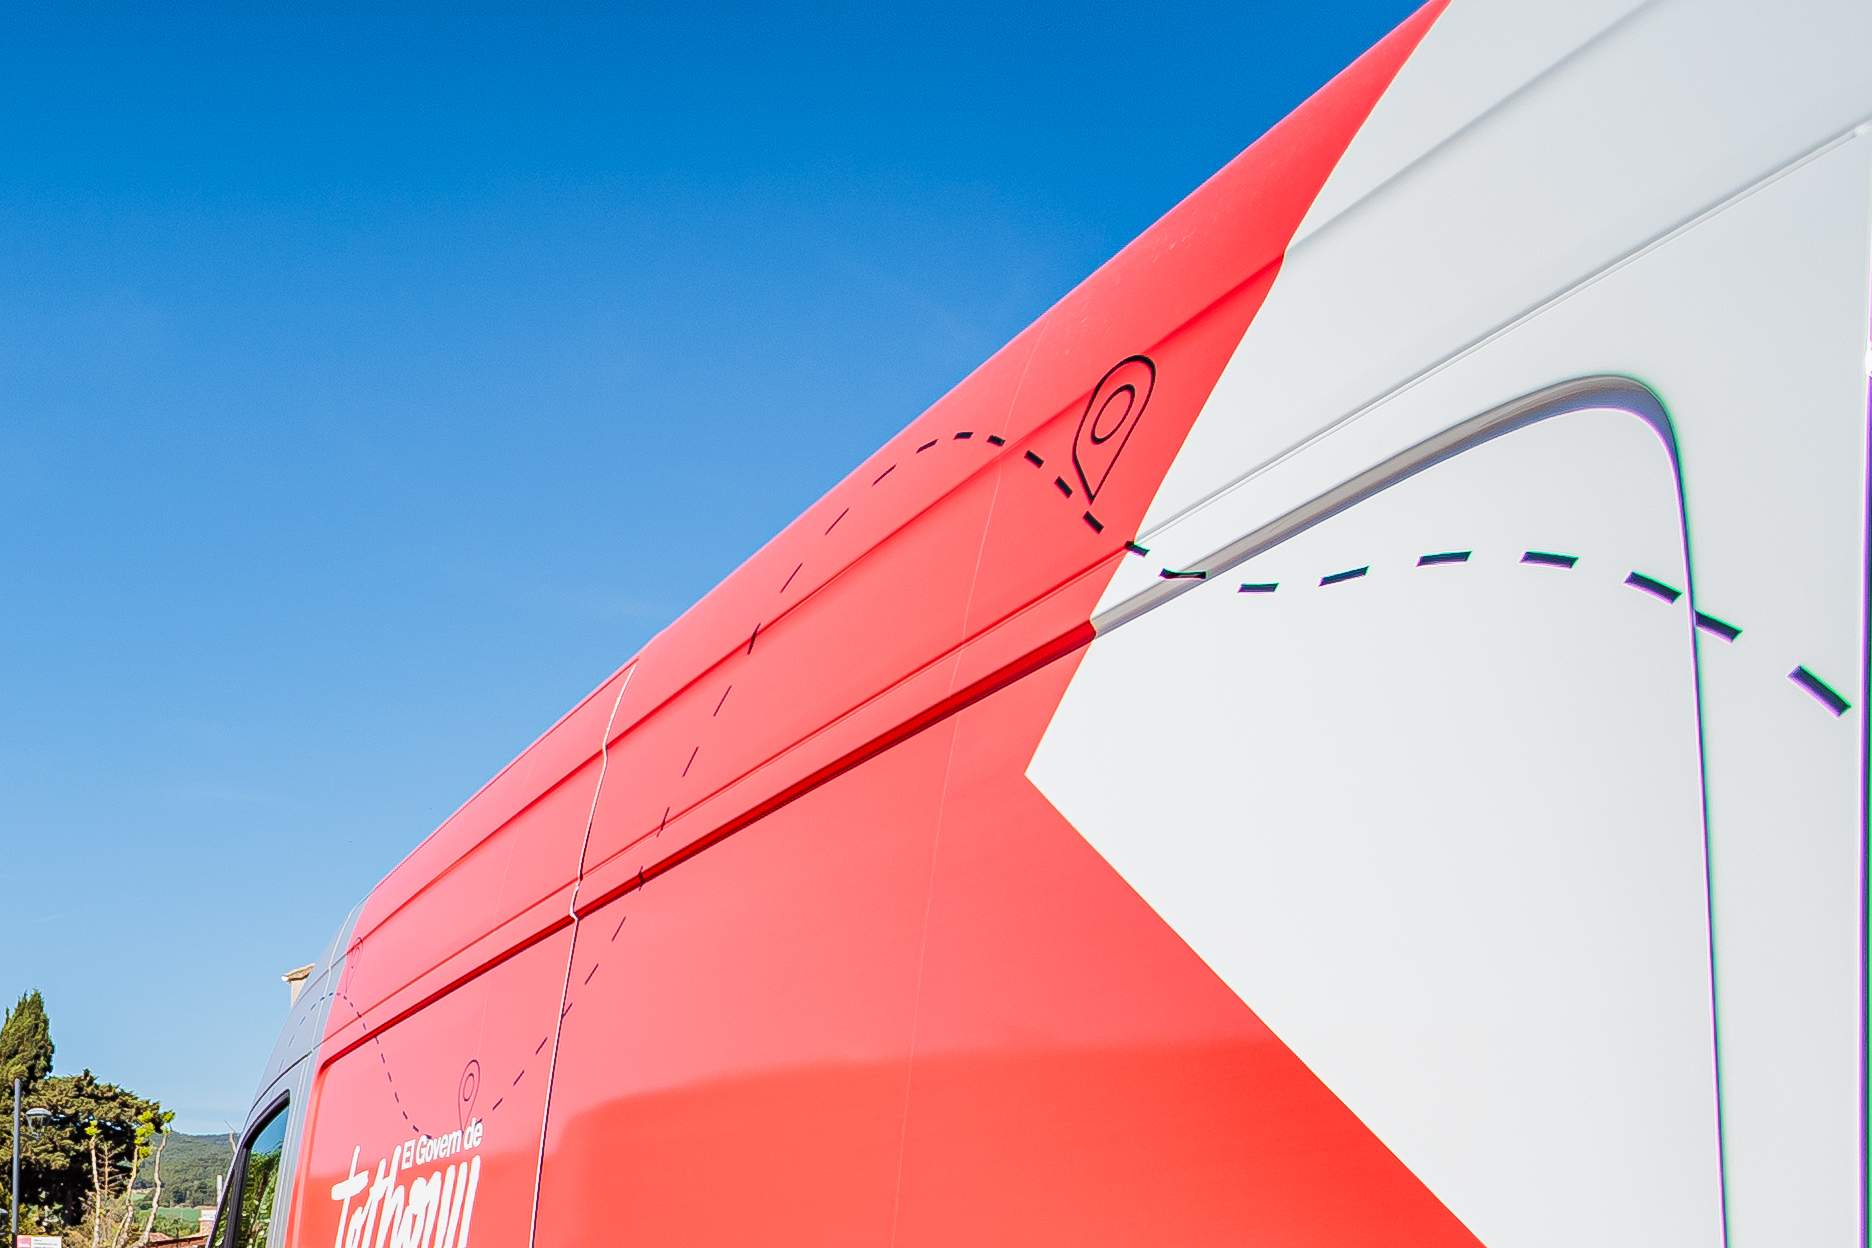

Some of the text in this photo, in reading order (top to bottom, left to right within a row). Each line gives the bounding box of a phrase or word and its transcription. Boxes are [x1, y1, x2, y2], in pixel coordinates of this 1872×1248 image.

[401, 1117, 484, 1170] El Govern de
